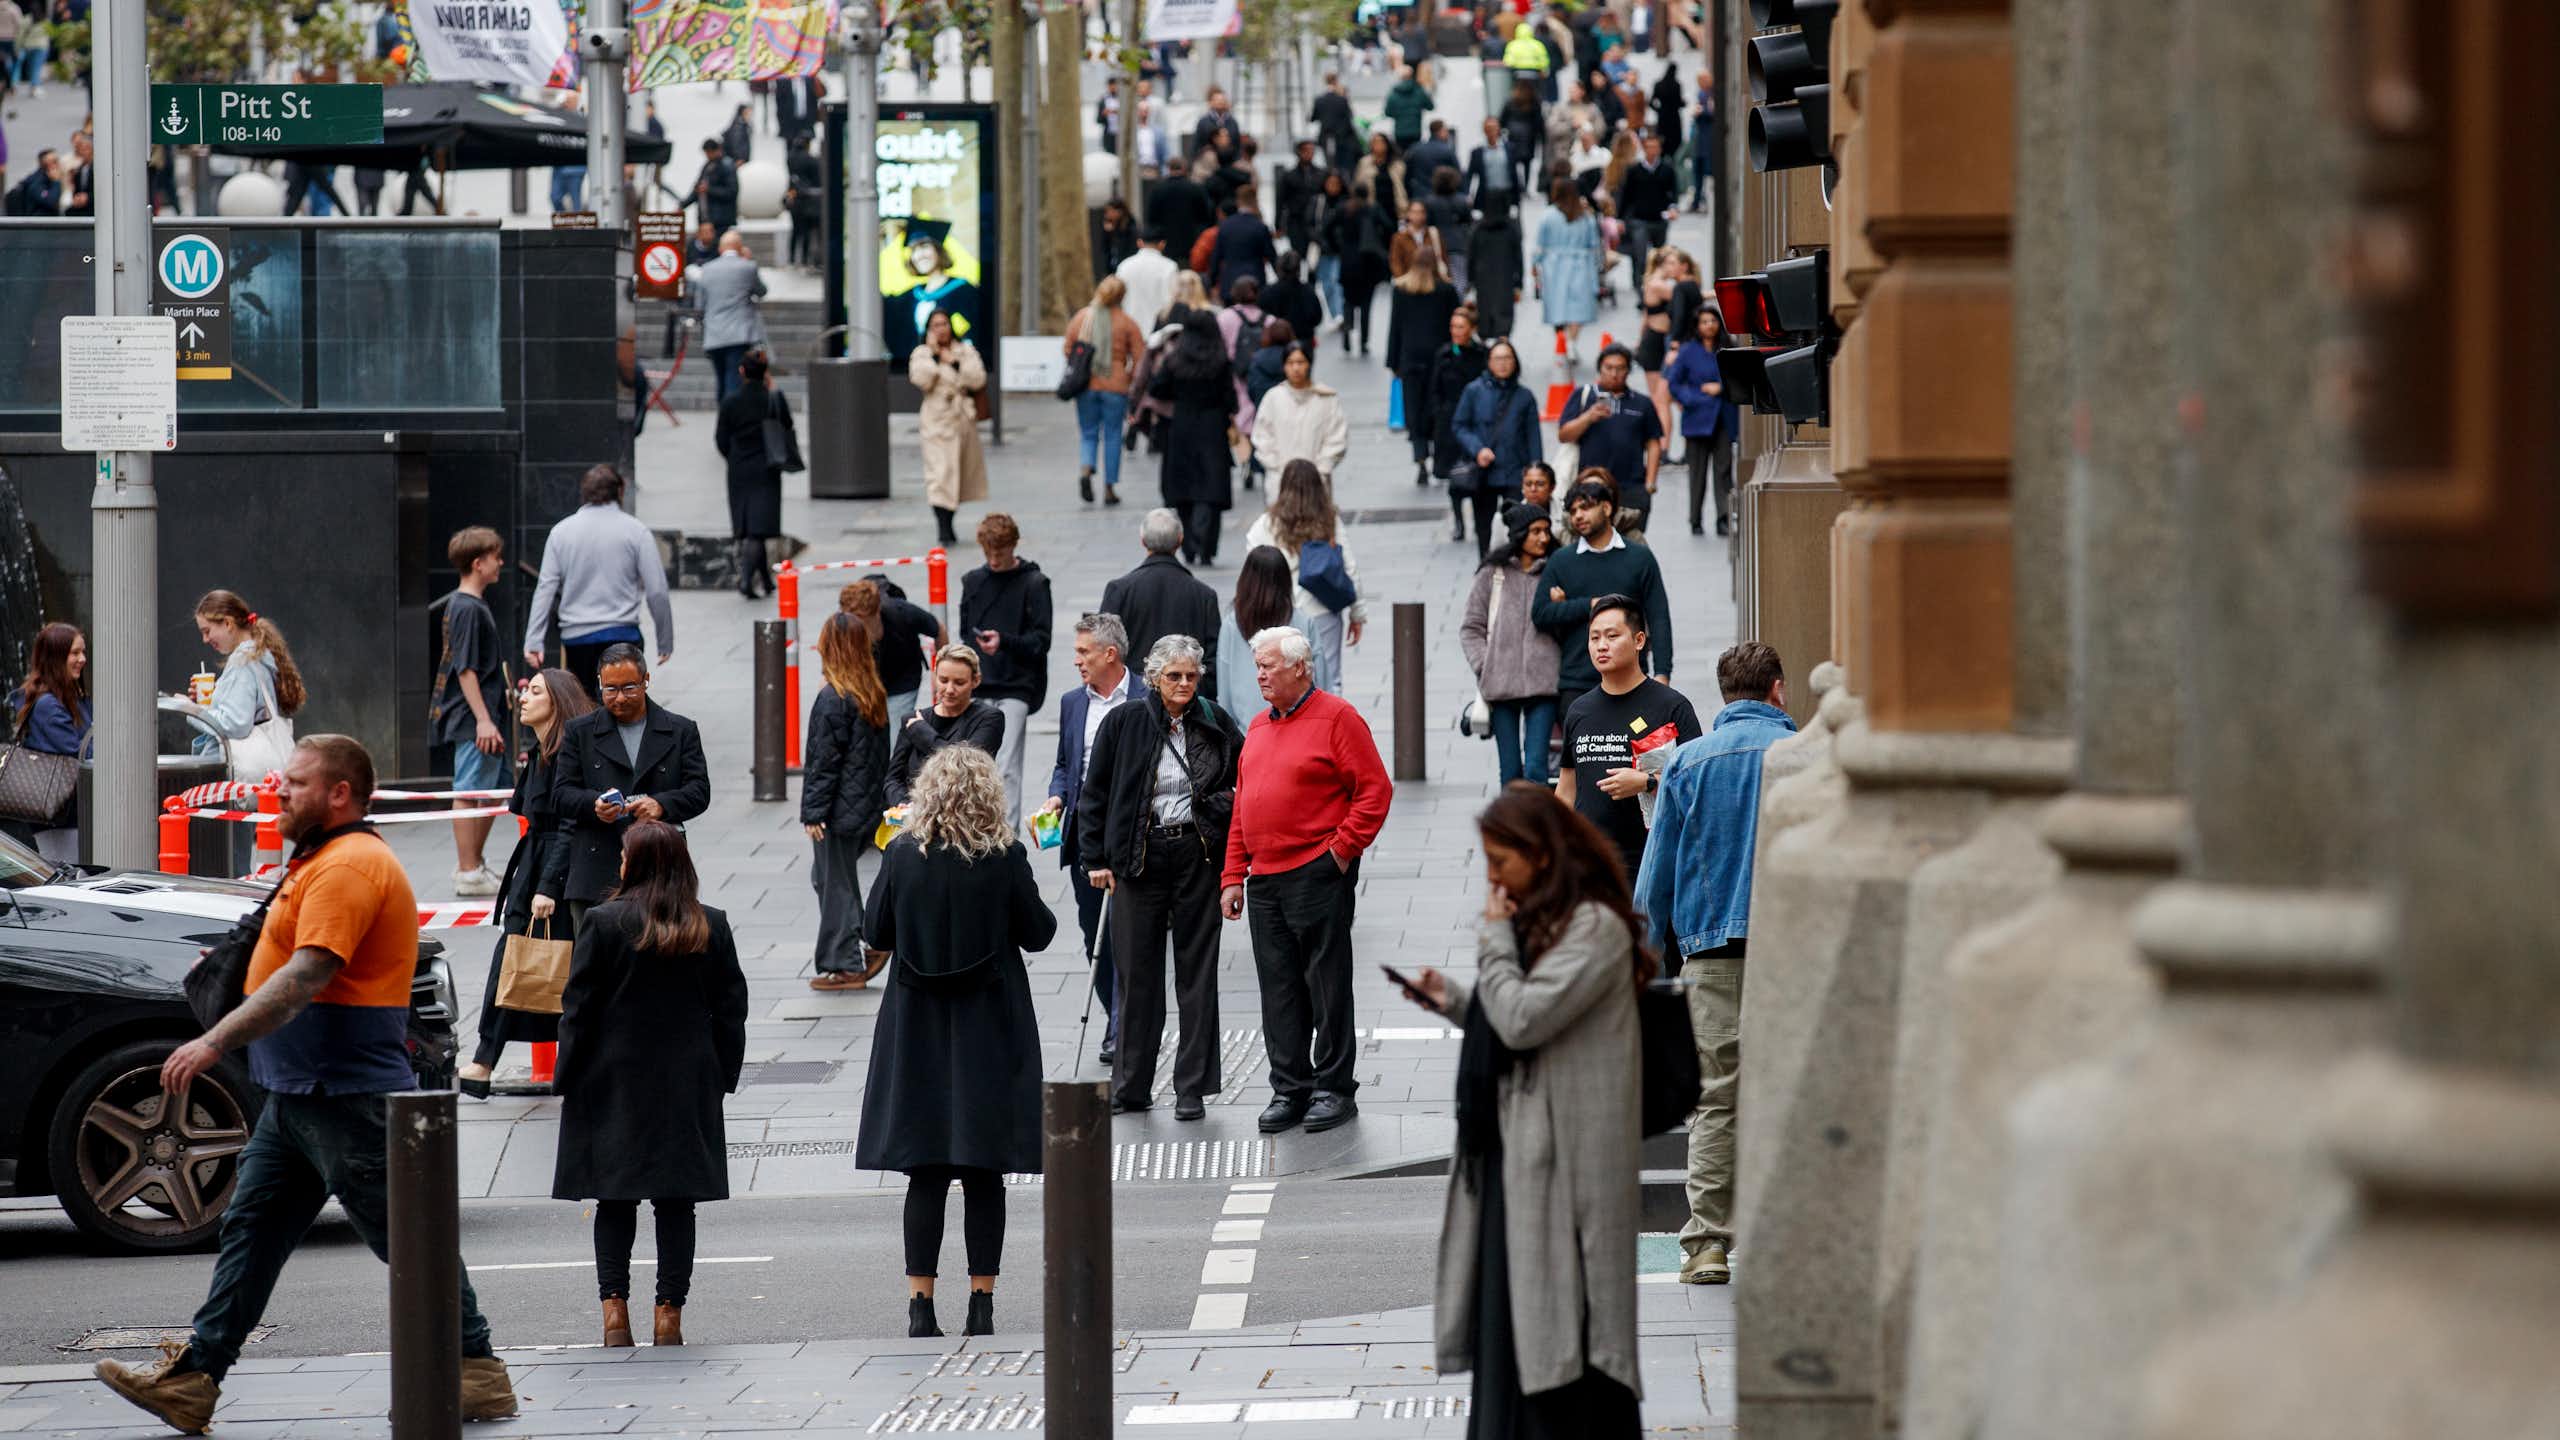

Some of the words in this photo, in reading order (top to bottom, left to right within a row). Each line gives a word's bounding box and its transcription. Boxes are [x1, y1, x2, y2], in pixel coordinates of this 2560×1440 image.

[220, 91, 272, 119] Pitt
[281, 91, 312, 119] St
[222, 126, 281, 142] 108-140
[875, 127, 965, 161] oubt
[876, 162, 959, 189] ever
[174, 249, 208, 284] M
[164, 306, 194, 318] Martin
[196, 306, 220, 318] Place
[185, 351, 191, 361] 3
[193, 350, 211, 361] min
[1577, 734, 1590, 744] Ask
[1591, 735, 1605, 743] me
[1605, 733, 1628, 742] about
[1576, 744, 1588, 753] QR
[1589, 743, 1626, 753] Cardless.
